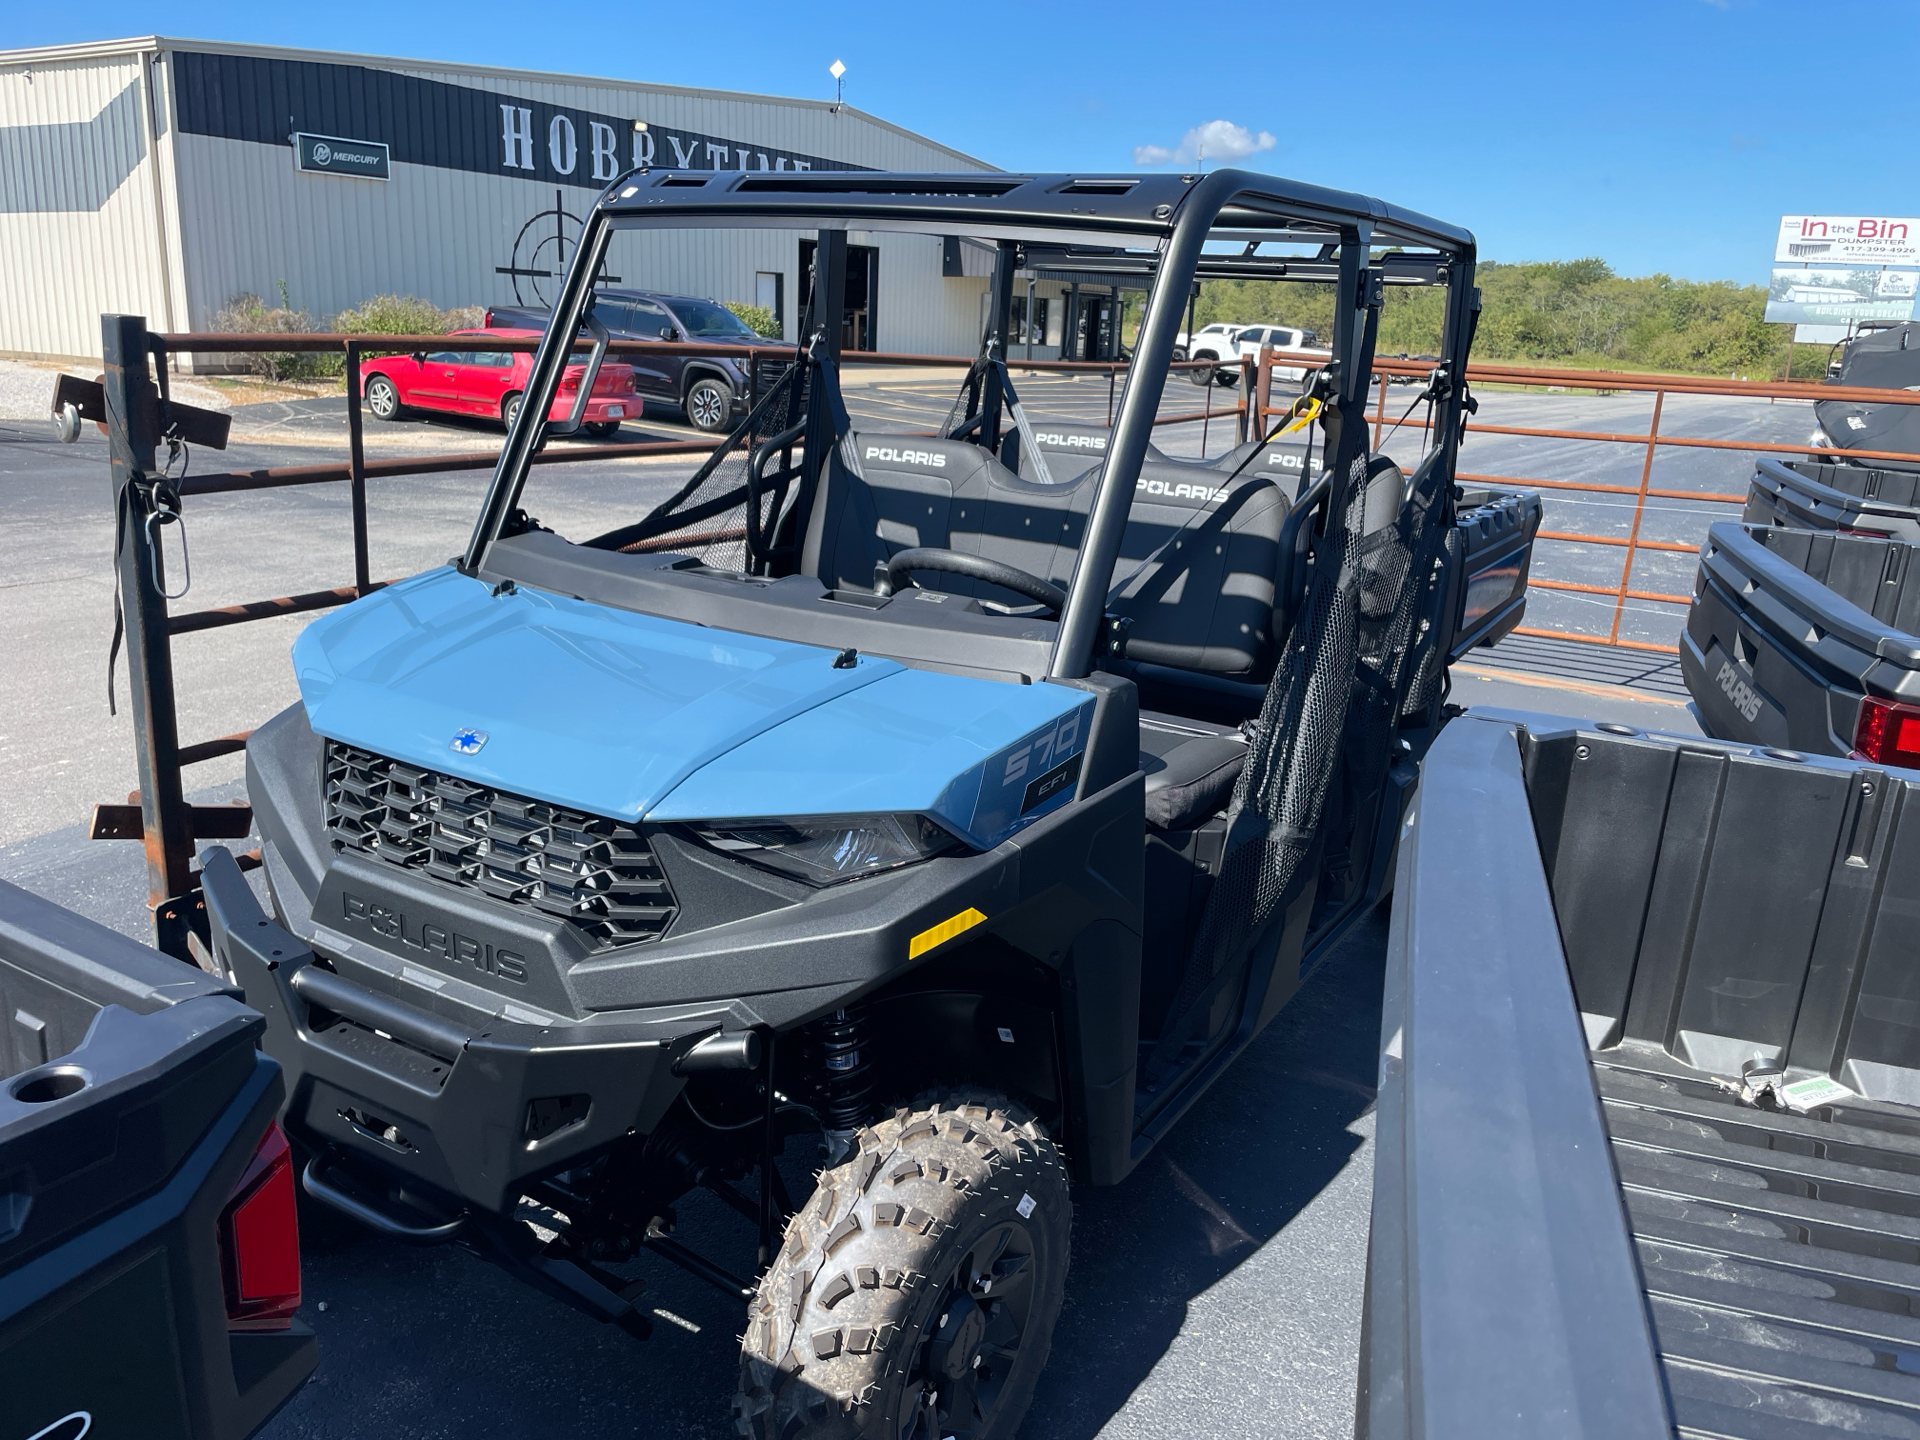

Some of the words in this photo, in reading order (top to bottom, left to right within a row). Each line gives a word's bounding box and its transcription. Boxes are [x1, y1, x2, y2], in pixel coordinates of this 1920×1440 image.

[333, 151, 379, 165] MERCURY
[1801, 218, 1828, 236] In
[1830, 225, 1855, 233] the
[1857, 219, 1908, 238] Bin
[1837, 237, 1906, 246] DUMPSTER
[1842, 246, 1916, 254] 417-399-4926
[1815, 306, 1851, 315] BUILDING
[1854, 308, 1875, 317] YOUR
[1876, 309, 1910, 319] DREAMS
[1035, 433, 1106, 449] POLARIS
[866, 447, 946, 468] POLARIS
[1135, 478, 1230, 503] POLARIS
[1716, 661, 1763, 722] POLARIS
[1002, 716, 1081, 787] 570
[1038, 771, 1067, 796] EFI
[343, 892, 529, 986] POLARIS
